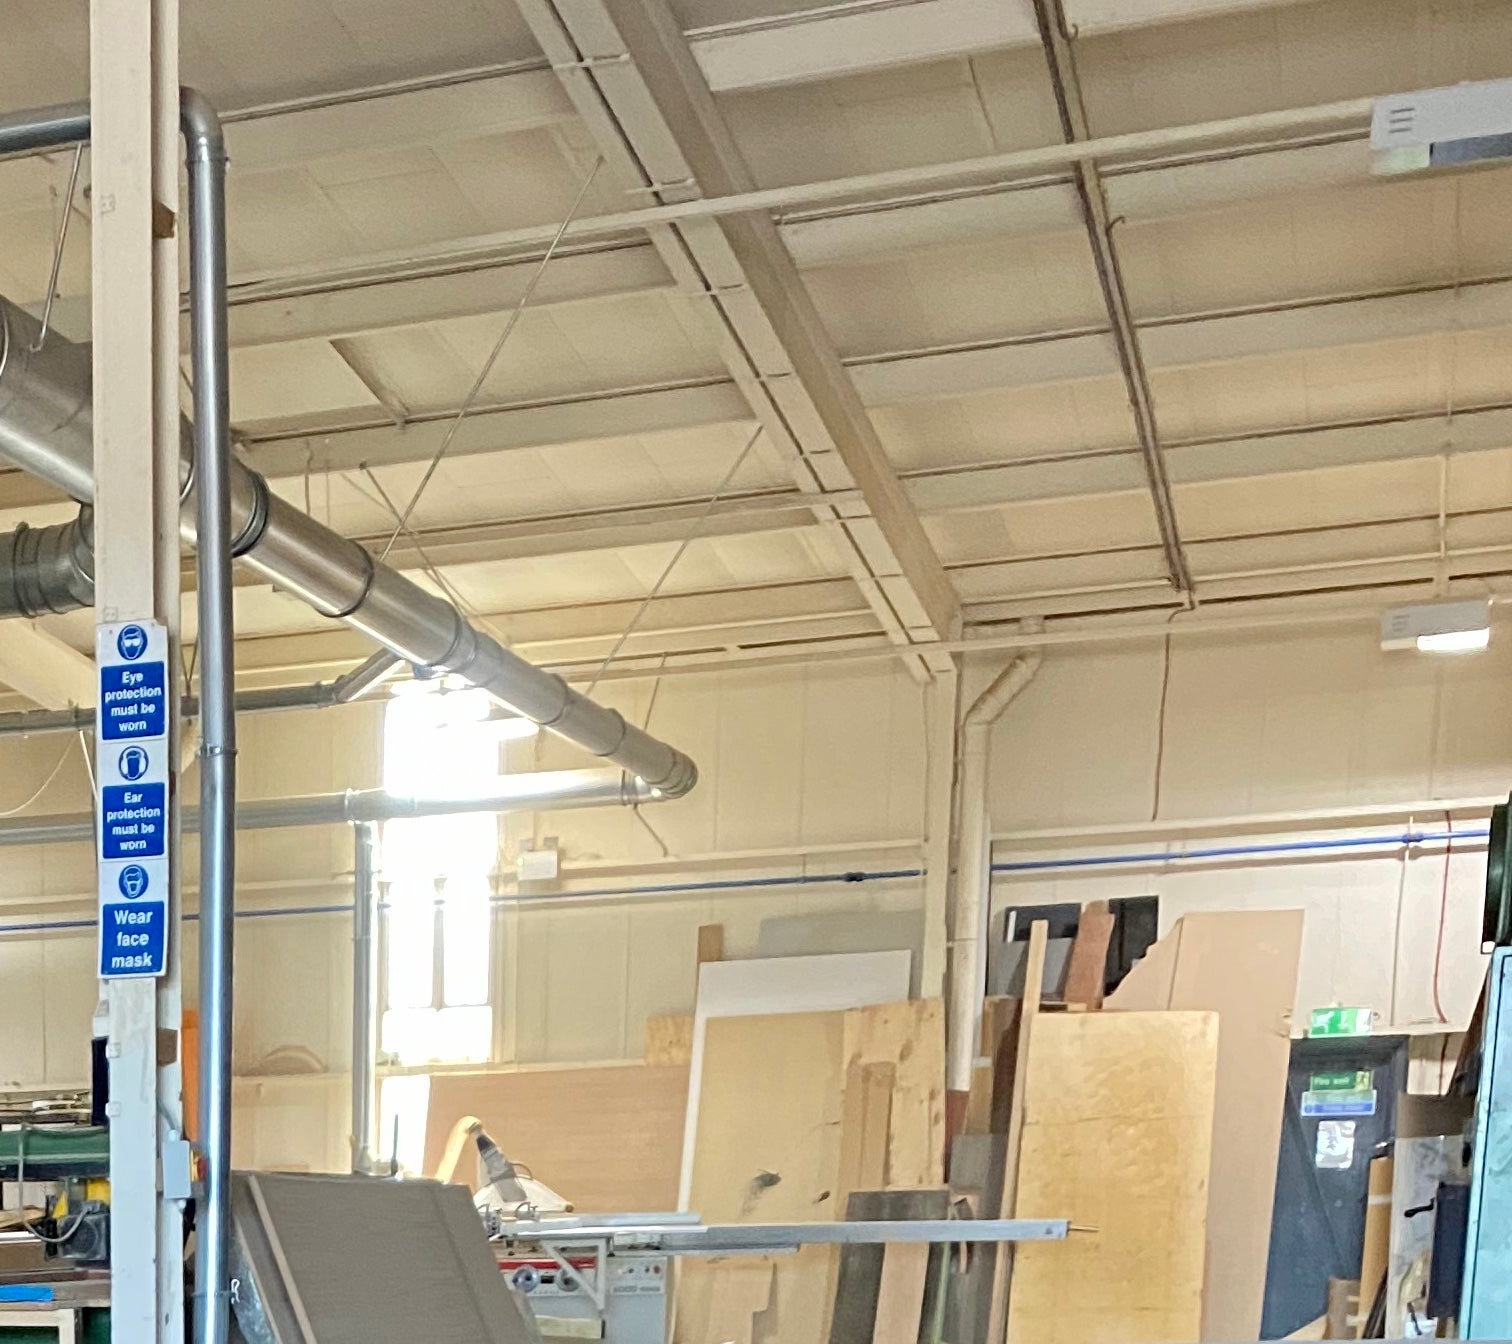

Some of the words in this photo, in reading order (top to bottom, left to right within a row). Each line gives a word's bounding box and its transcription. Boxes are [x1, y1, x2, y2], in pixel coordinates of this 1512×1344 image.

[122, 671, 144, 686] Eye
[104, 686, 162, 704] protection
[111, 703, 138, 717] must
[140, 702, 156, 714] be
[118, 720, 147, 732] worn
[124, 791, 143, 804] Ear
[106, 806, 161, 823] protection
[112, 823, 138, 835] must
[140, 822, 155, 834] be
[119, 840, 147, 851] worn
[113, 909, 153, 925] Wear
[116, 931, 150, 947] face
[111, 951, 153, 969] mask
